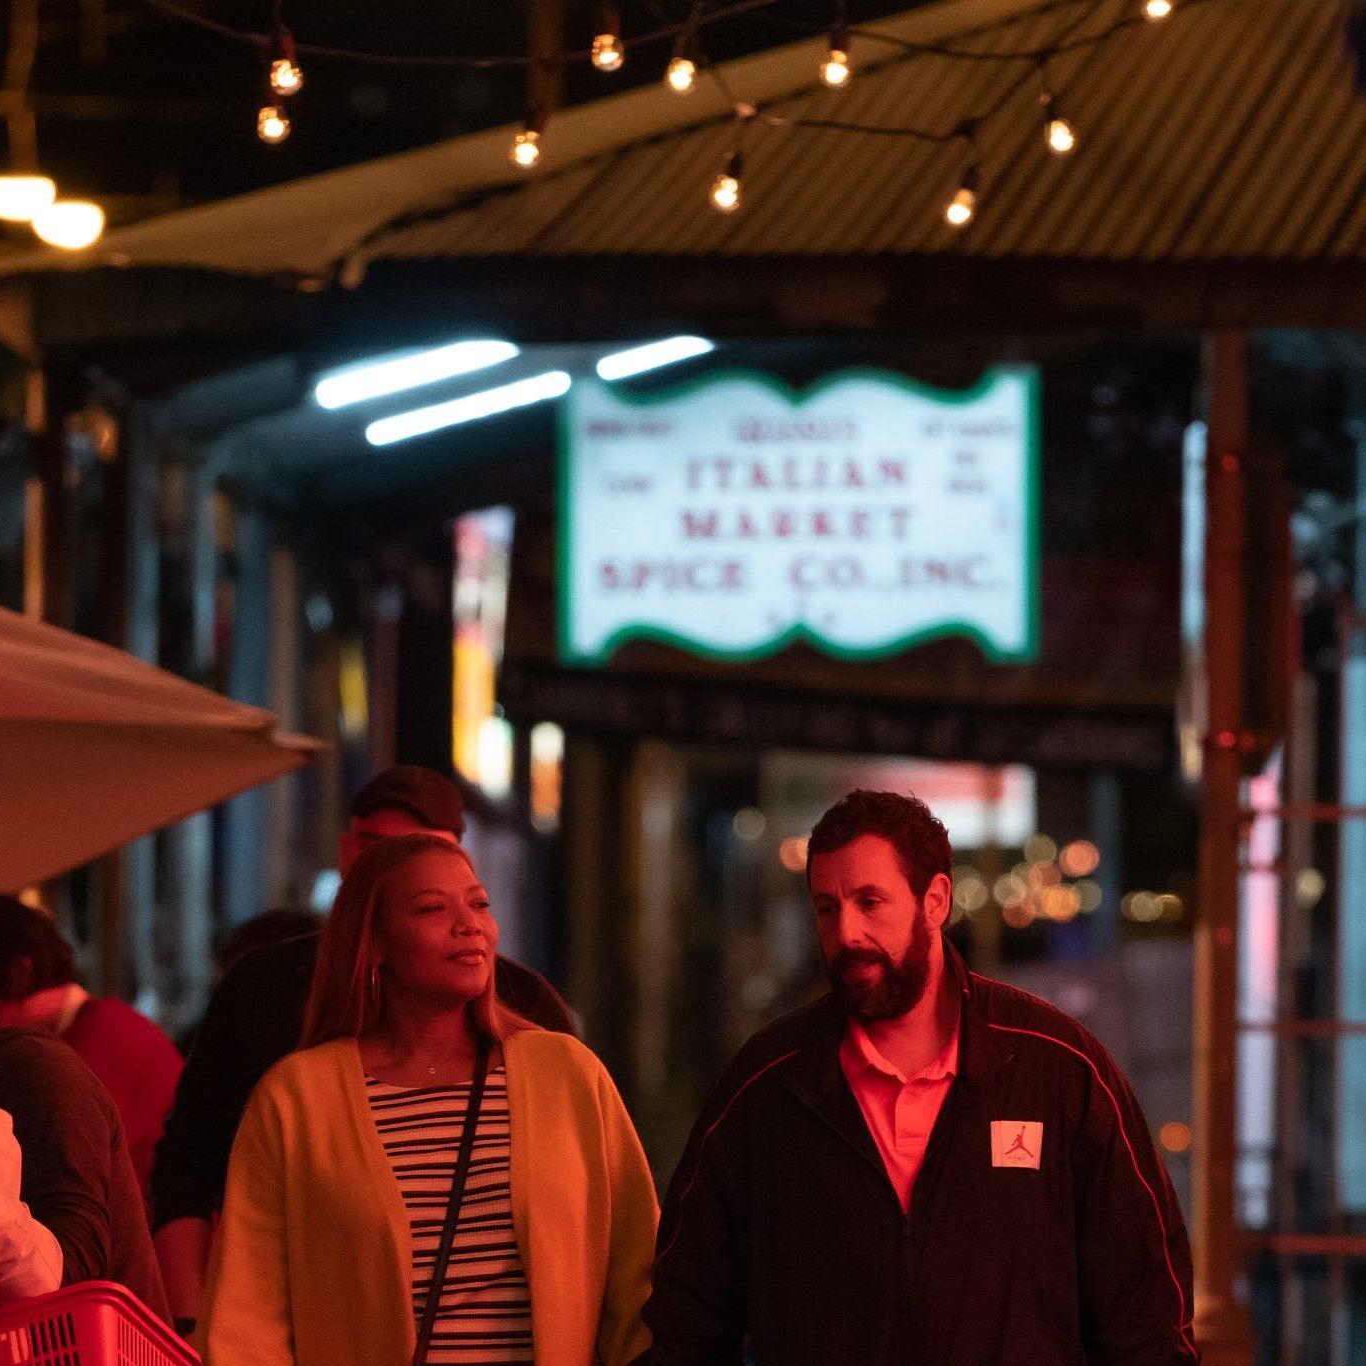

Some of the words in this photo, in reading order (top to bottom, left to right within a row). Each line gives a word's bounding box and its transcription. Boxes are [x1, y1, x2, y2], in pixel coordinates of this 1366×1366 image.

[684, 455, 907, 492] ITALIAN
[678, 506, 912, 542] MARKET
[598, 557, 746, 593] SPICE
